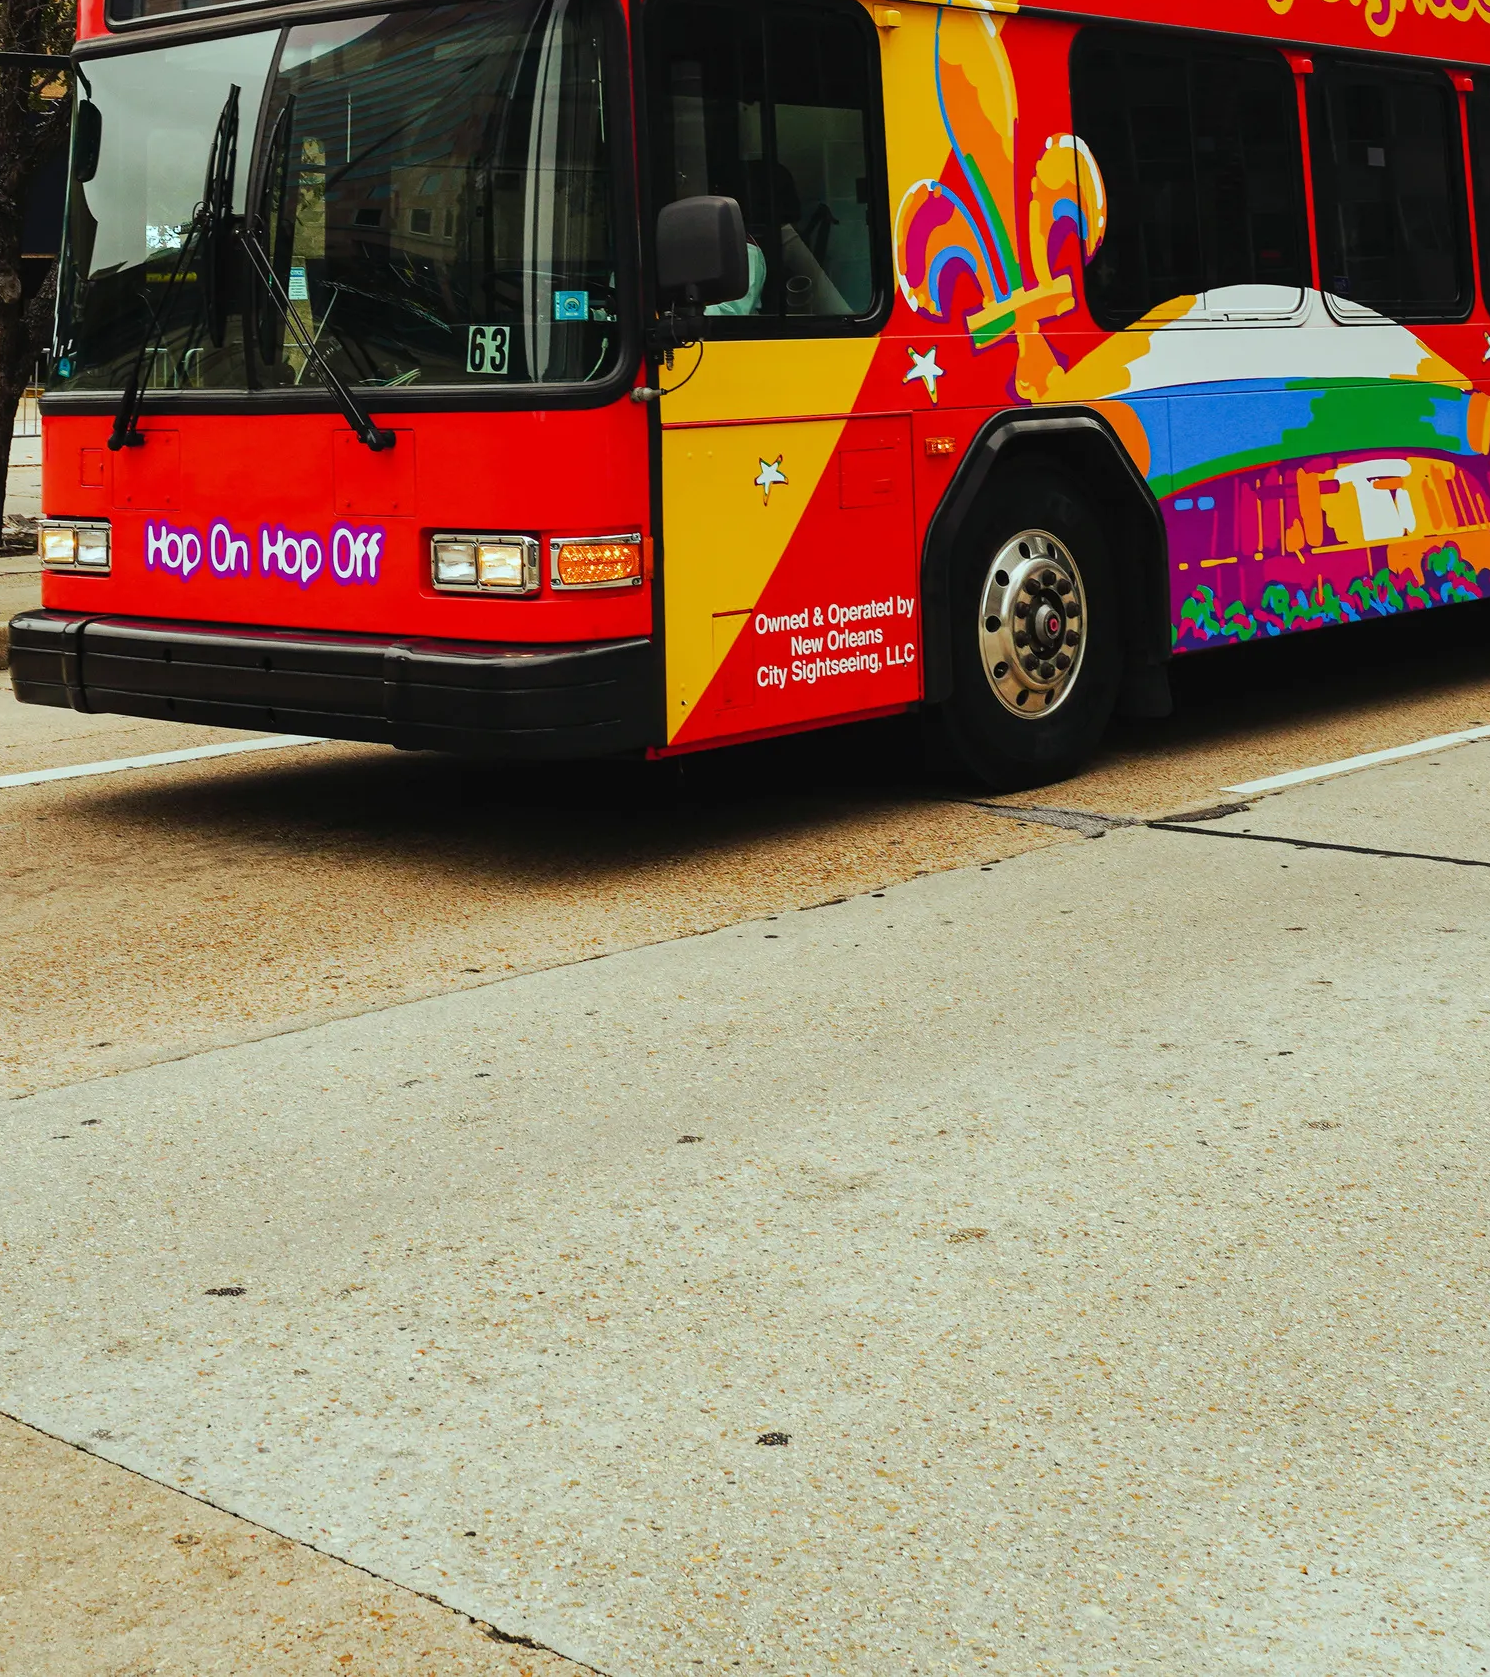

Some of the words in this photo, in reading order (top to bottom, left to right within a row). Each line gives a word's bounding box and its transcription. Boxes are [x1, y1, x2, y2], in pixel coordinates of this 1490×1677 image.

[470, 327, 507, 372] 63
[147, 525, 202, 577] Hop
[210, 523, 249, 572] On
[262, 529, 322, 583] Hop
[332, 527, 383, 579] Off
[755, 608, 809, 635] Owned
[813, 606, 824, 627] &
[828, 596, 894, 628] Operated
[897, 595, 914, 618] by
[791, 636, 824, 656] New
[827, 628, 884, 651] Orleans
[757, 666, 788, 689] City
[791, 651, 882, 684] Sightseeing,
[886, 643, 915, 666] LLC
